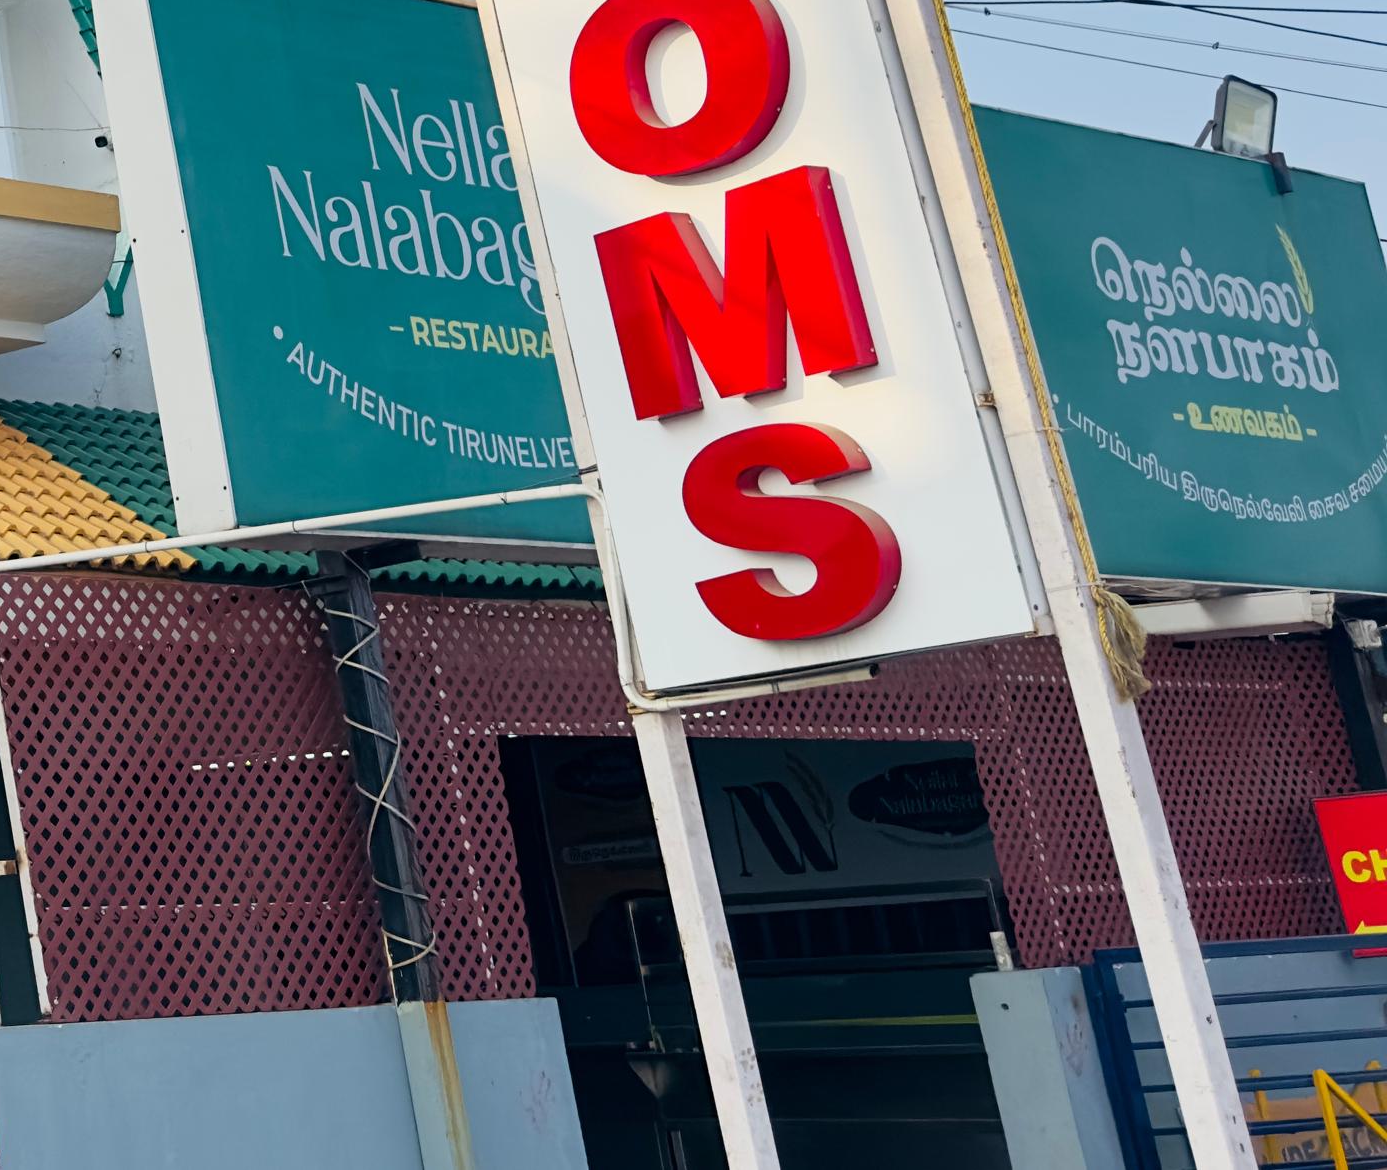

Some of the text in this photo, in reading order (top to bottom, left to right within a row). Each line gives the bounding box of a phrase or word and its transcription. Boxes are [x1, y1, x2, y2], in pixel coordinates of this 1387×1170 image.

[1091, 236, 1302, 327] நெல்லை
[1106, 318, 1339, 393] நளபாகம்
[286, 341, 577, 469] AUTHENTIC TIRUNELVE
[1067, 403, 1178, 491] பாரம்பரிய
[1187, 402, 1303, 442] உணவகம்
